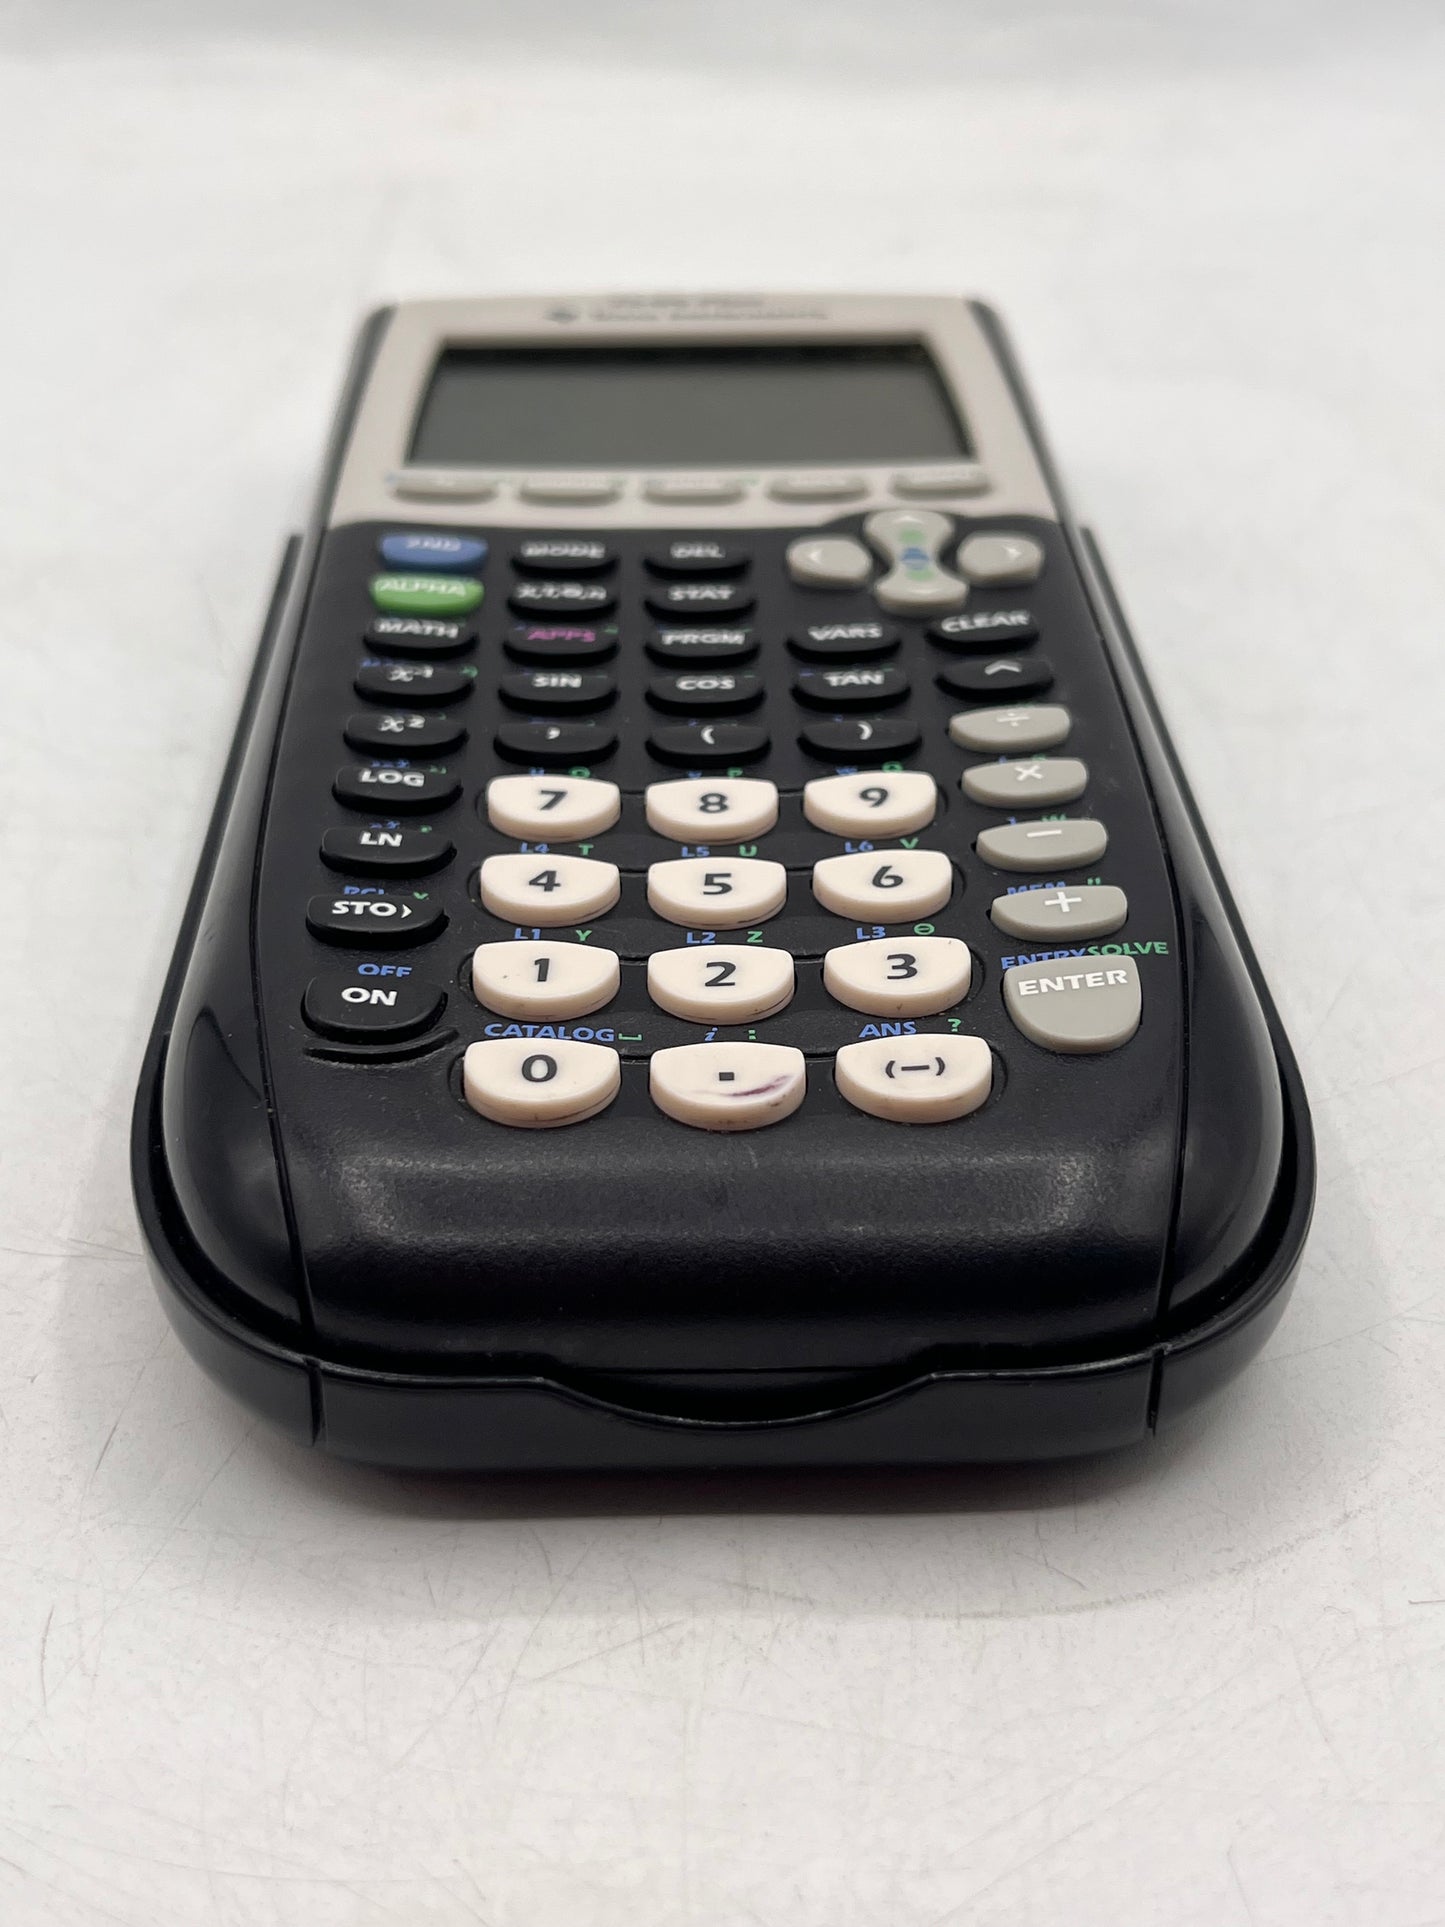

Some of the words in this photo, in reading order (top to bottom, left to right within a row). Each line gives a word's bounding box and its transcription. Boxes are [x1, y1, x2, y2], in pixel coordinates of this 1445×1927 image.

[376, 579, 466, 596] ALPHA
[668, 586, 735, 600] STAT
[375, 619, 459, 638] MATH
[941, 610, 1030, 632] CLEAR
[527, 628, 595, 642] APPS
[661, 629, 746, 645] PRGM
[808, 623, 883, 641] VARS
[532, 673, 582, 688] SIN
[676, 676, 736, 691] COS
[823, 671, 884, 686] TAN
[360, 769, 424, 787] LOG
[539, 790, 567, 810] 7
[699, 793, 729, 813] 8
[859, 787, 889, 807] 9
[360, 831, 402, 847] LN
[900, 838, 919, 849] V
[579, 844, 594, 856] T
[739, 845, 757, 857] U
[528, 870, 561, 892] 4
[702, 873, 733, 895] 5
[872, 866, 904, 888] 6
[514, 928, 541, 940] L1
[575, 929, 592, 941] Y
[686, 932, 716, 944] L2
[746, 931, 763, 943] Z
[856, 926, 886, 940] L3
[1086, 941, 1169, 957] SOLVE
[357, 963, 412, 977] OFF
[533, 958, 550, 982] 1
[704, 961, 737, 987] 2
[887, 953, 918, 980] 3
[1018, 969, 1128, 996] ENTER
[341, 987, 398, 1006] ON
[484, 1023, 615, 1042] CATALOG
[858, 1021, 917, 1037] ANS
[947, 1018, 962, 1033] ?
[521, 1054, 557, 1082] 0
